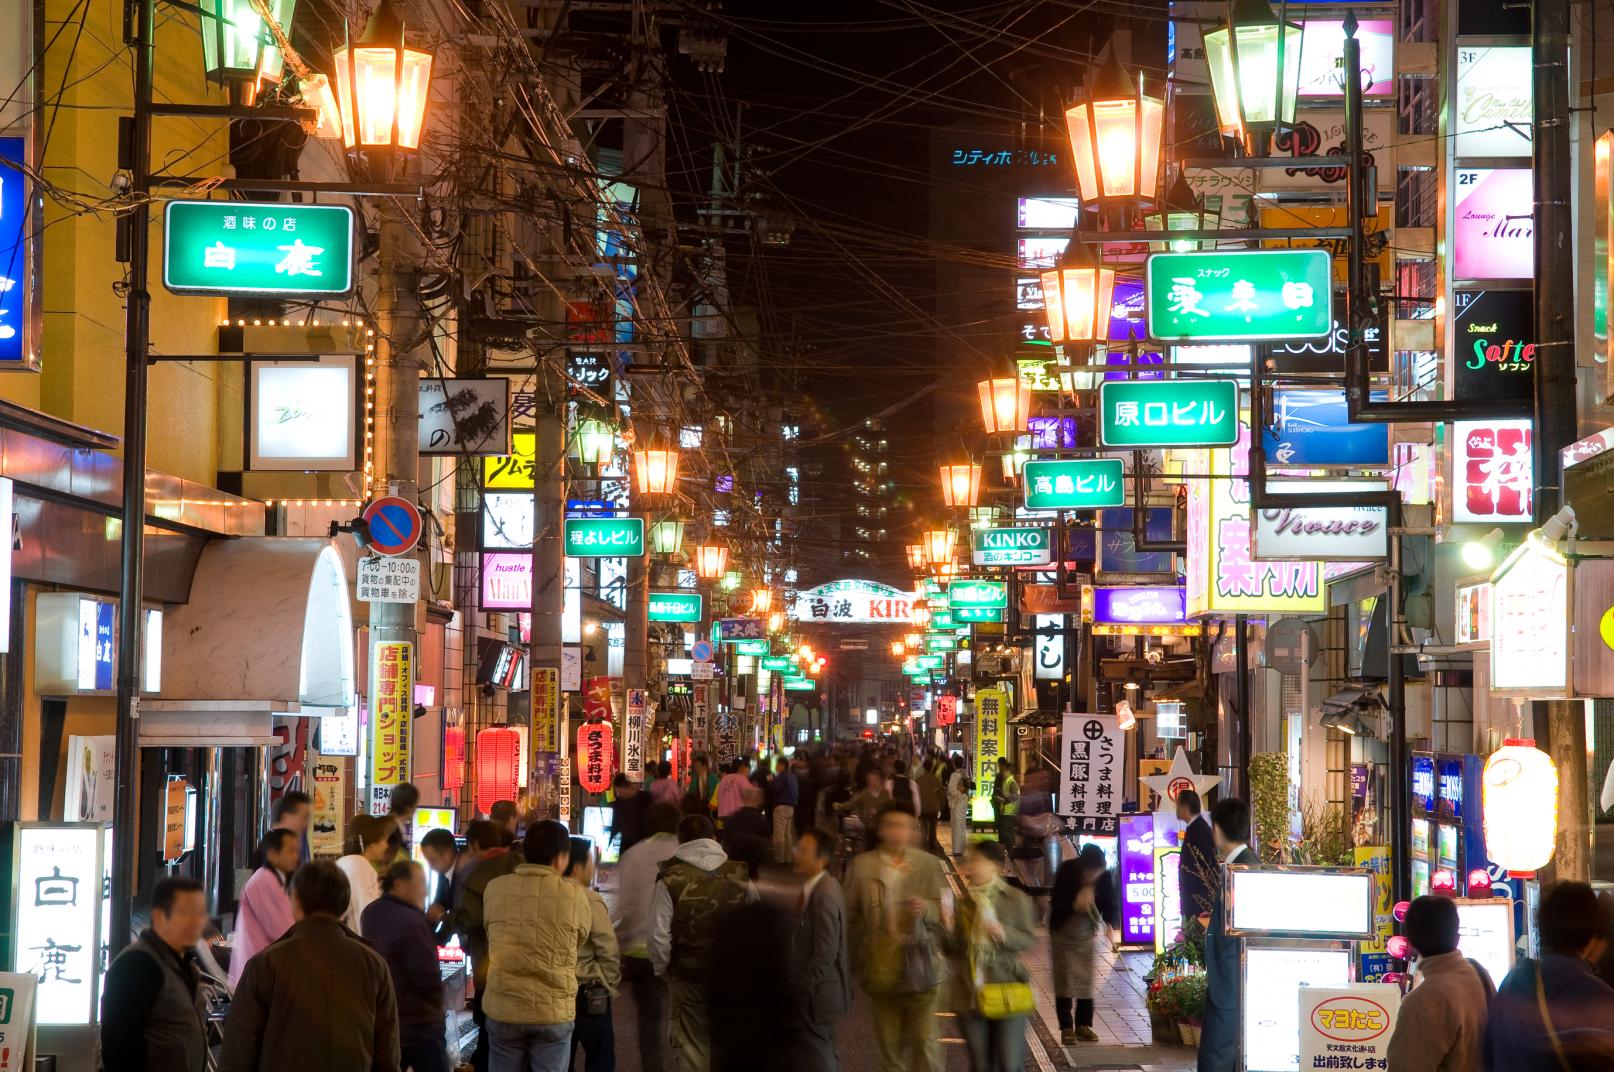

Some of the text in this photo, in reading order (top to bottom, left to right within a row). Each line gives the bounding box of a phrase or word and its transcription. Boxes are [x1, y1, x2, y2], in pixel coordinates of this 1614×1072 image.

[1460, 51, 1476, 64] 3F
[1459, 173, 1478, 185] 2F
[1462, 211, 1496, 221] Lounge
[223, 216, 297, 232] 酒味の店
[1197, 267, 1231, 279] スナック
[1455, 294, 1471, 307] 1F
[1467, 323, 1498, 333] Snack
[575, 357, 597, 365] BAR
[1114, 400, 1226, 427] 原口ビル
[1034, 473, 1116, 496] 高島ビル
[983, 533, 1042, 548] KINKO
[984, 551, 1042, 562] 酒のキンコー
[495, 563, 526, 572] hustle
[361, 574, 416, 587] 貨物の集配中の
[360, 587, 416, 601] 貨物車を除く
[811, 598, 854, 618] 白波
[1040, 620, 1062, 669] すし
[379, 645, 398, 782] 店舗専門ショップ
[628, 715, 641, 772] 柳川氷室
[980, 697, 999, 797] 無料案内所
[588, 730, 603, 784] さつま料理
[1070, 741, 1090, 815] 黒豚料理
[1096, 736, 1114, 815] さつま料理
[1065, 817, 1115, 832] 専門店
[1318, 1008, 1383, 1031] マヨたこ
[1312, 1055, 1388, 1071] 出前致します
